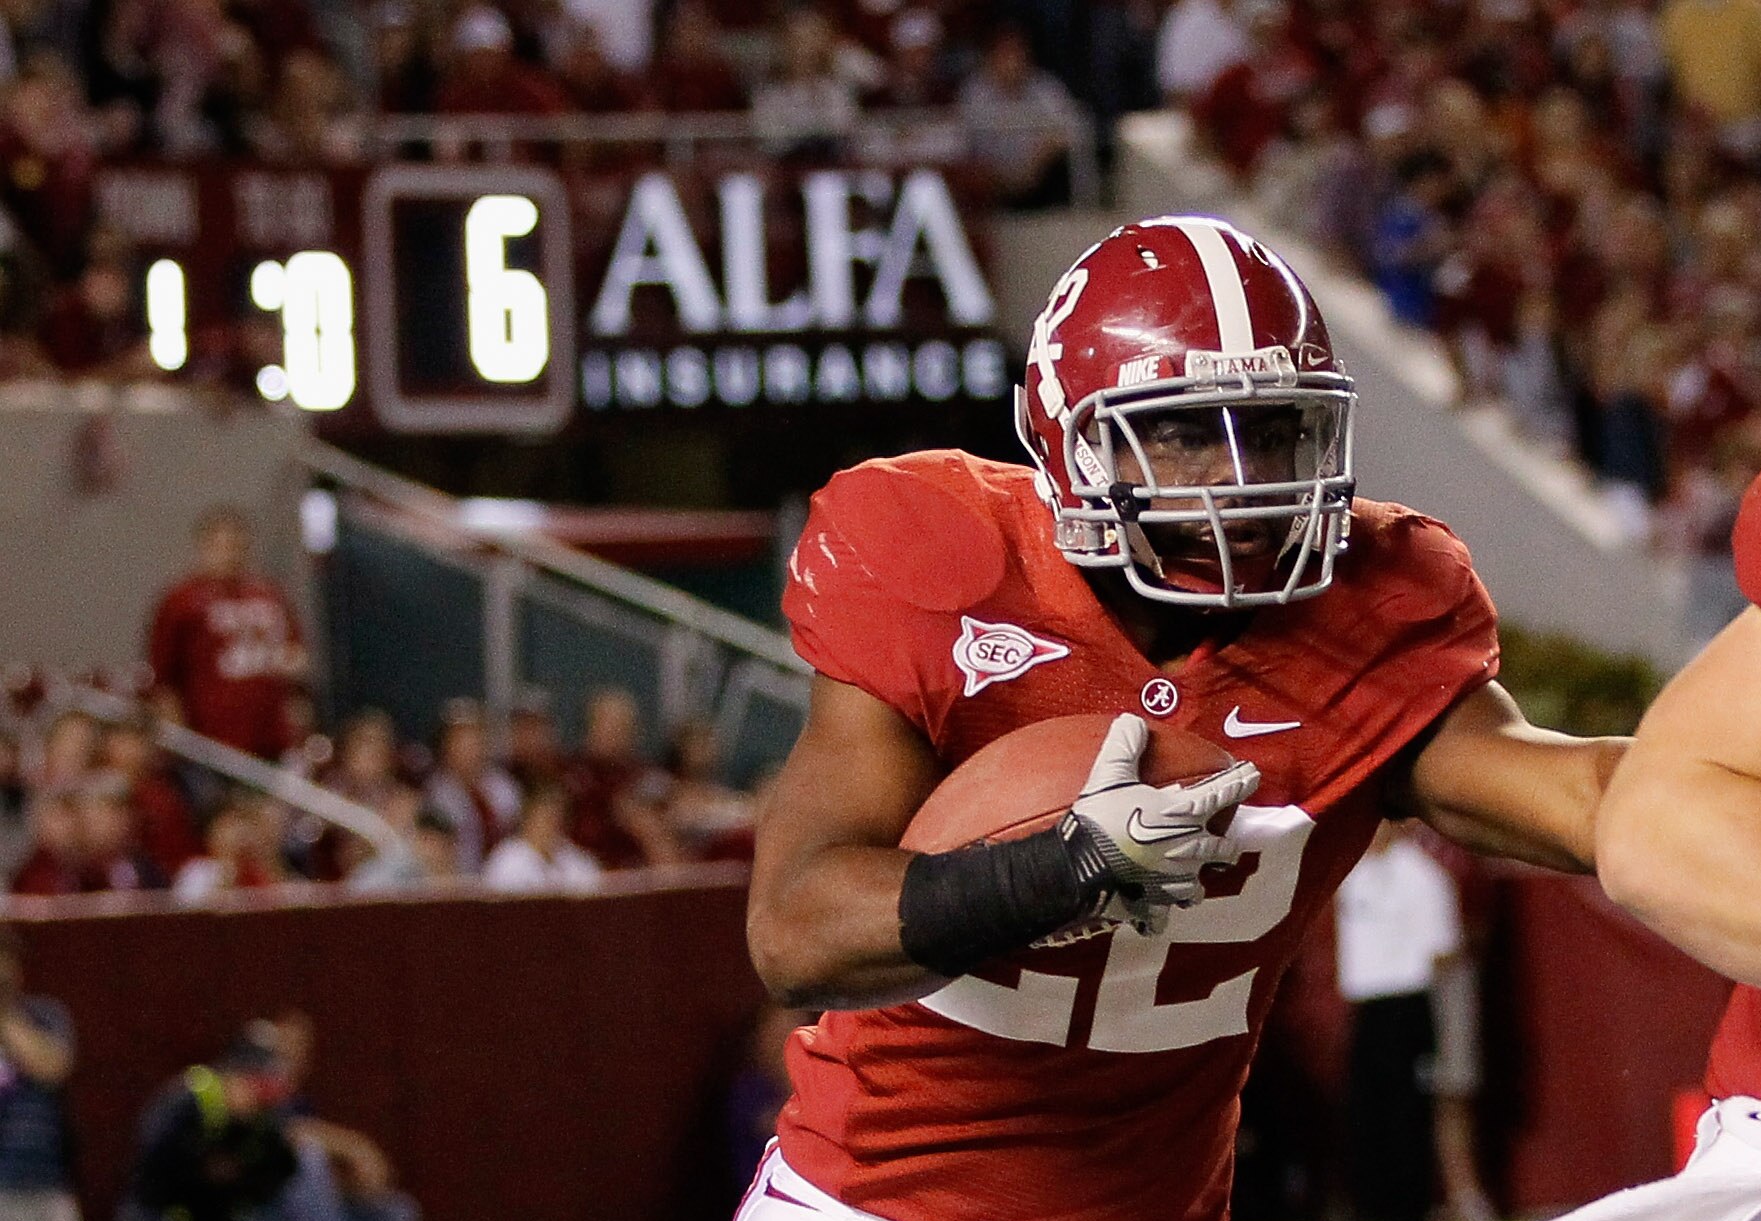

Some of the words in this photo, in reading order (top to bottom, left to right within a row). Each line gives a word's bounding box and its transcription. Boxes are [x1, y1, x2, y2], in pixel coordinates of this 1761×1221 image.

[464, 195, 548, 382] 6
[590, 171, 996, 337] ALFA
[582, 338, 1004, 409] INSURANCE
[1117, 355, 1161, 387] NIKE
[975, 640, 1021, 667] SEC
